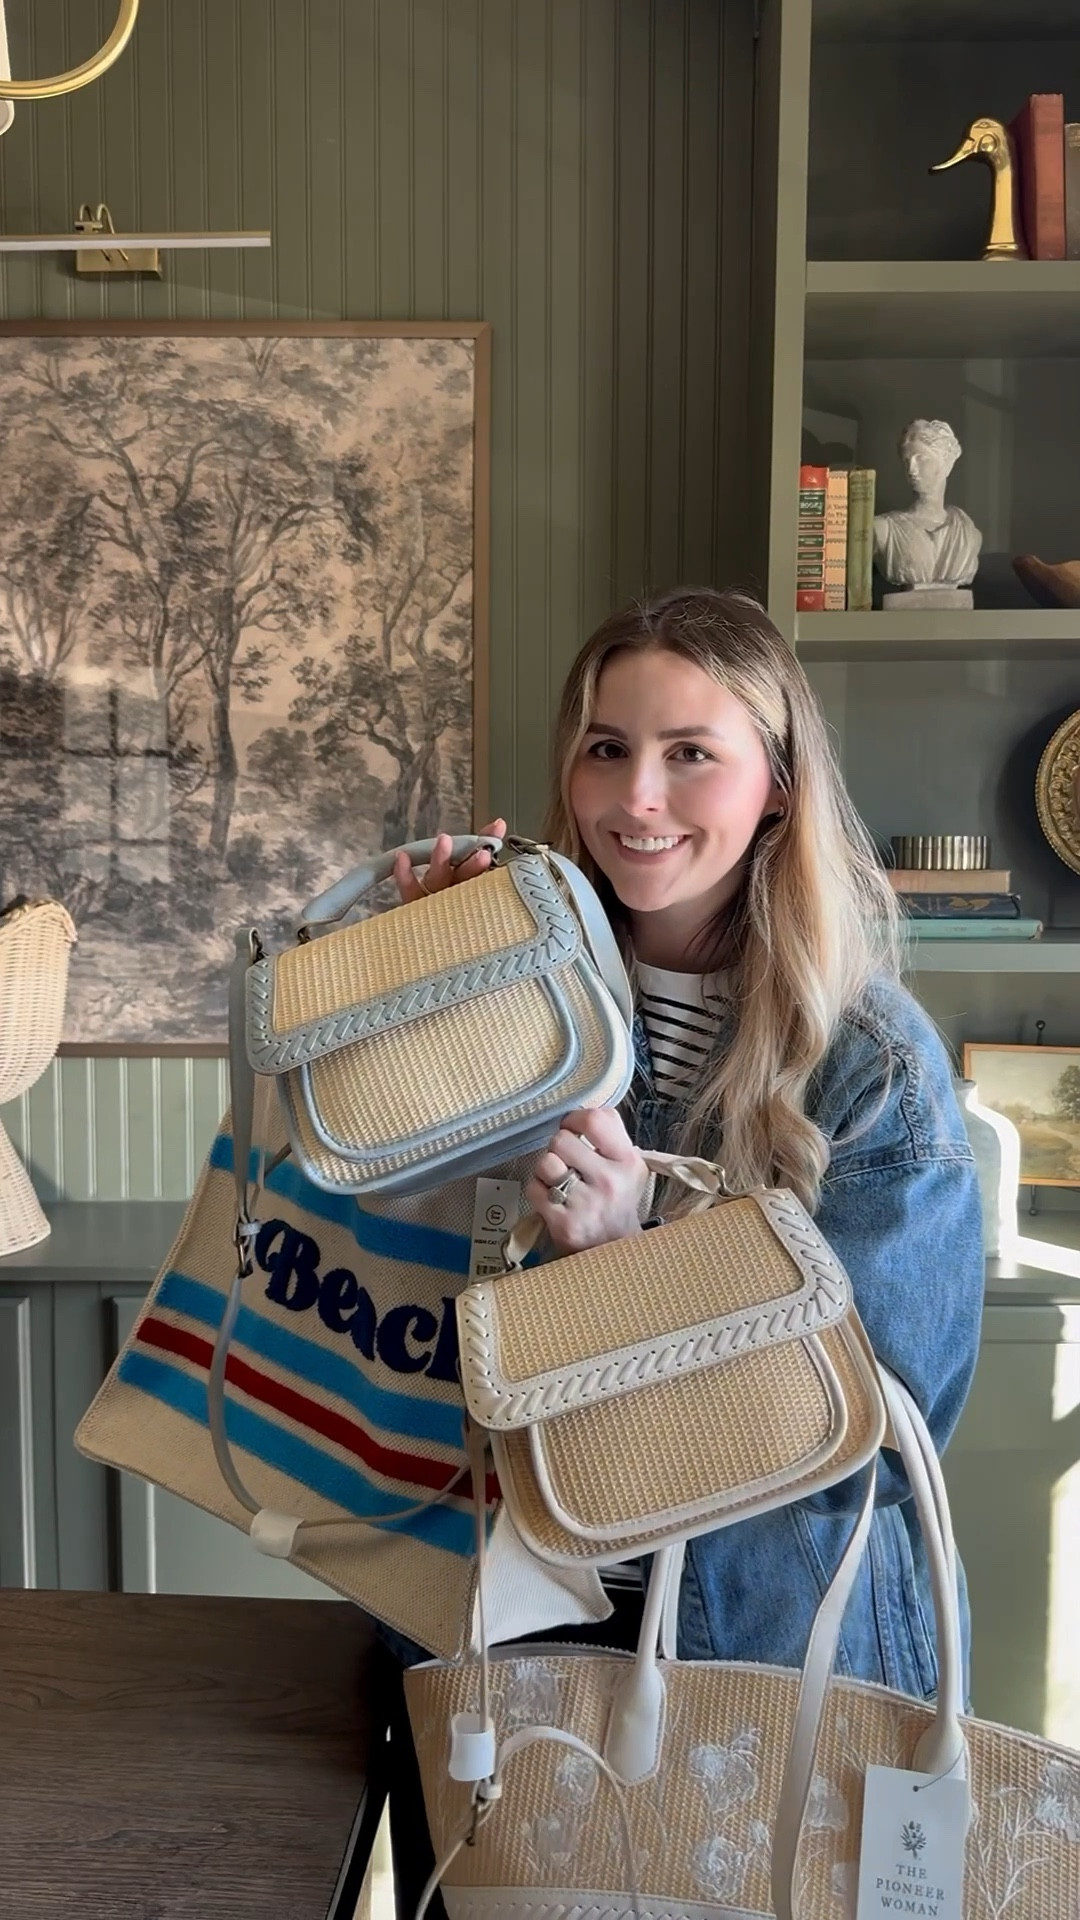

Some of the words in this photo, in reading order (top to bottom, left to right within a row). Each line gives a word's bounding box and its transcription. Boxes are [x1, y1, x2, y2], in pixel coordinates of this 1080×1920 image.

[896, 1864, 927, 1879] THE
[876, 1877, 945, 1901] PIONEER
[881, 1896, 939, 1917] WOMAN
